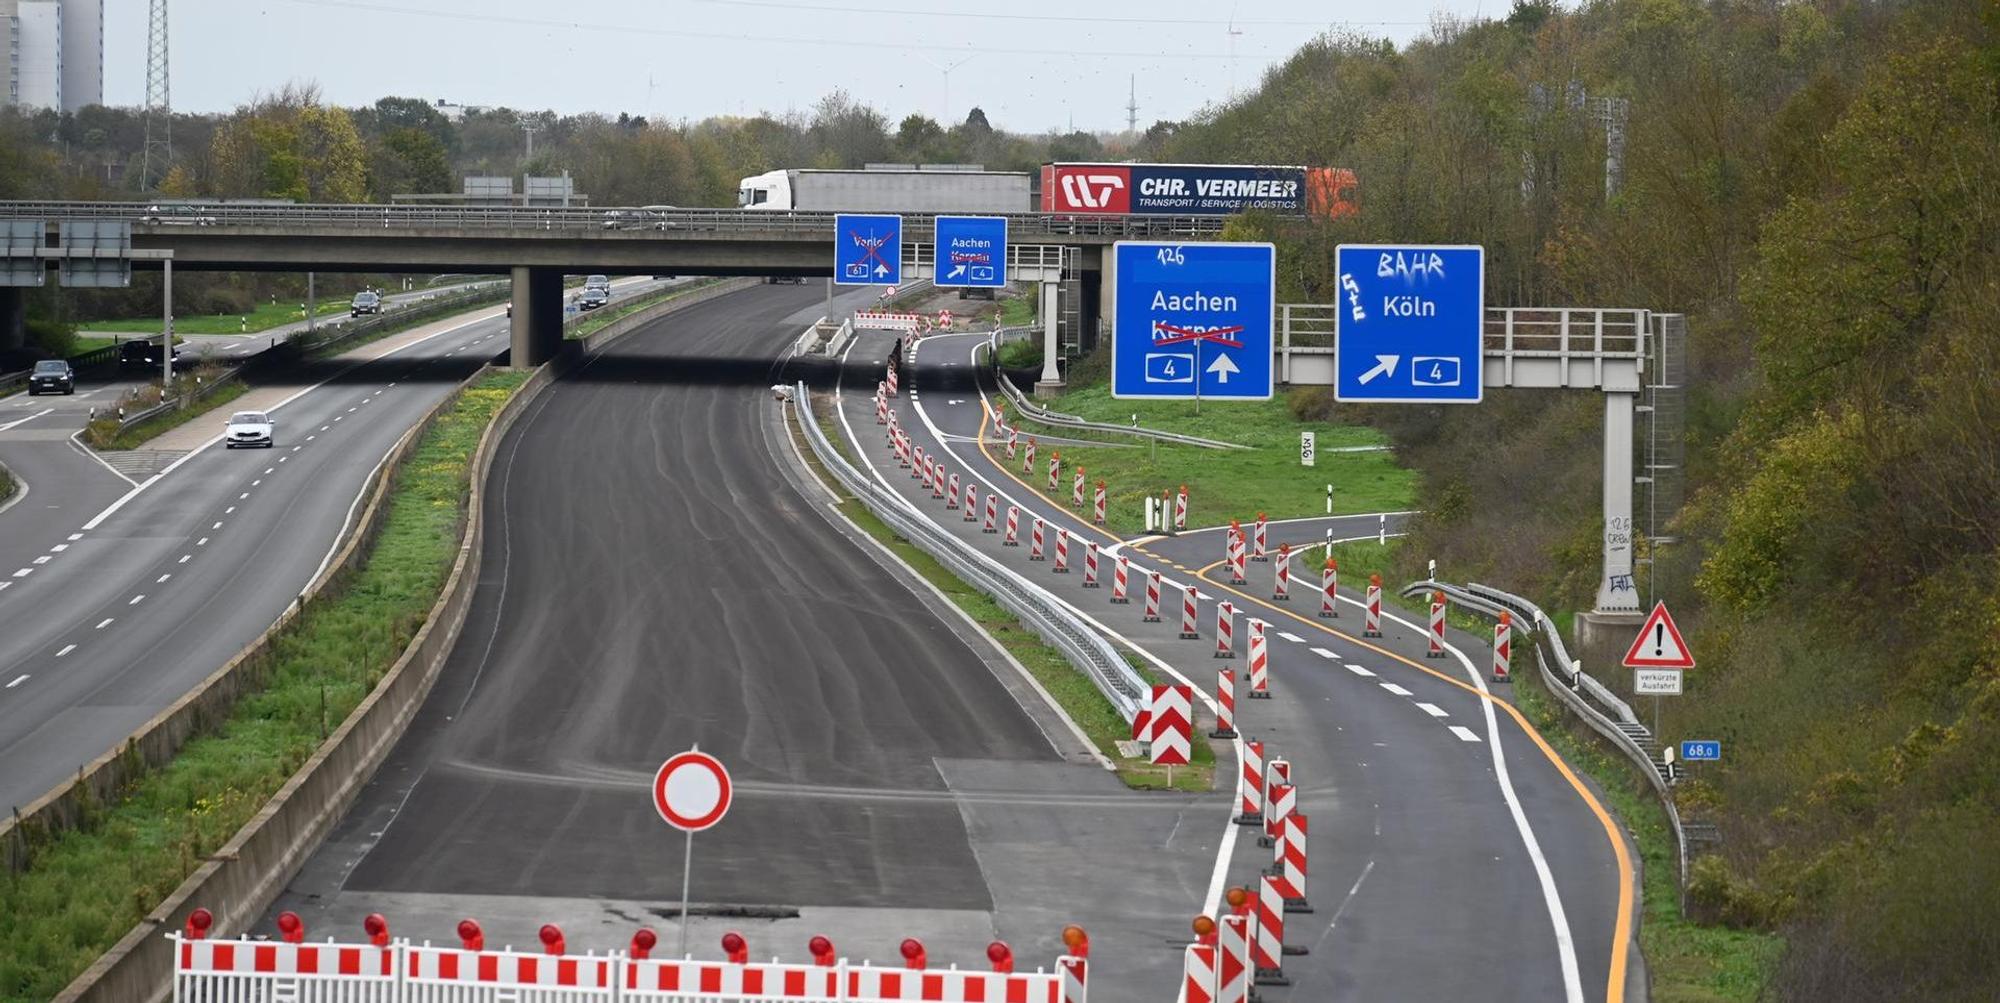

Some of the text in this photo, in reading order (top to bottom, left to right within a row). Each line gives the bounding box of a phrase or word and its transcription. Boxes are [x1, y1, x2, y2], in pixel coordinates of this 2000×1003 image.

[1140, 178, 1298, 198] CHR. VERMEER
[1139, 198, 1194, 207] TRANSPORT
[1201, 199, 1241, 208] SERVICE
[1248, 200, 1297, 209] LOGISTICS
[951, 238, 991, 248] Aachen
[1157, 246, 1185, 266] 126
[1377, 251, 1446, 279] BAHR
[853, 266, 862, 275] 61
[979, 269, 986, 278] 4
[1151, 290, 1237, 311] Aachen
[1383, 295, 1436, 317] Köln
[1163, 359, 1176, 377] 4
[1430, 362, 1442, 380] 4
[1642, 682, 1676, 690] Ausfahrt
